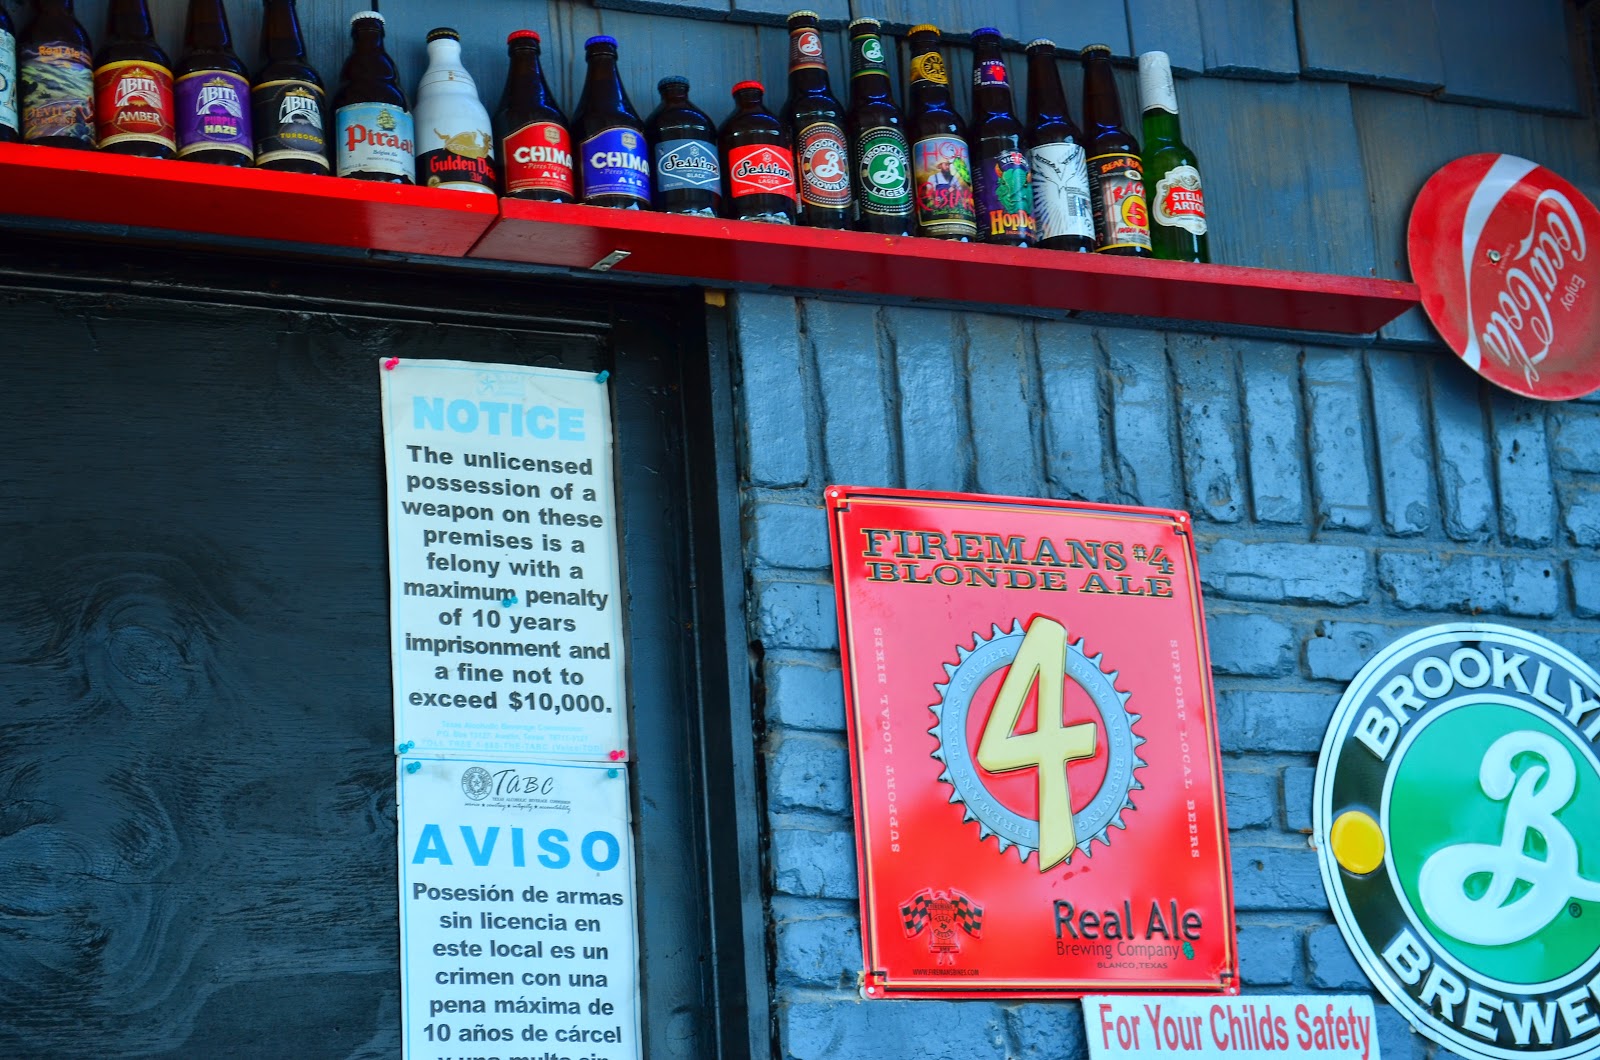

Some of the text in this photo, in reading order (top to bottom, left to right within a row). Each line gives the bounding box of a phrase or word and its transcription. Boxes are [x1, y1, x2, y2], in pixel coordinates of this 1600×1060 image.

[38, 46, 62, 56] Real
[116, 75, 160, 106] ABITA
[196, 85, 239, 114] ABITA
[116, 110, 162, 127] AMBER
[278, 96, 320, 121] ABITA
[204, 116, 236, 127] PURPLE
[204, 124, 237, 136] HAZE
[513, 146, 573, 170] CHIMA
[590, 152, 650, 176] CHIMA
[664, 154, 718, 176] Session
[862, 144, 907, 166] BROOKLYN
[1102, 159, 1124, 174] BEAR
[430, 156, 496, 180] Gulden Dra
[542, 171, 567, 181] ALE
[738, 162, 793, 180] Session
[618, 176, 642, 186] ALE
[806, 172, 840, 190] BROWN
[872, 186, 906, 198] LAGER
[1126, 202, 1147, 226] 5
[1173, 201, 1204, 212] ARTO
[989, 209, 1036, 235] HopDe
[1483, 189, 1586, 391] Coca-Cola
[1563, 274, 1586, 312] Enjoy
[412, 396, 586, 441] NOTICE
[406, 444, 593, 476] The unlicensed
[406, 474, 597, 502] possession of a
[401, 501, 603, 528] weapon on these
[423, 529, 585, 554] premises is a
[860, 528, 1175, 576] FIREMANS #4
[426, 552, 584, 580] felony with a
[866, 561, 1174, 598] BLONDE ALE
[404, 581, 609, 612] maximum penalty
[438, 608, 576, 634] of 10 years
[405, 632, 610, 660] imprisonment and
[434, 662, 584, 686] a fine not to
[408, 691, 612, 715] exceed $10,000.
[874, 627, 900, 853] SUPPORT LOCAL BIKES
[977, 614, 1097, 874] 4
[1071, 661, 1126, 832] REAL ALE BREWING
[1170, 639, 1200, 858] SUPPORT LOCAL BEERS
[412, 824, 620, 872] AVISO
[412, 882, 624, 906] Posesión de armas
[439, 912, 601, 932] sin licencia en
[1053, 898, 1202, 940] Real Ale
[432, 940, 609, 960] este local es un
[1056, 941, 1180, 960] Brewing Company
[434, 967, 608, 988] crimen con una
[430, 996, 614, 1018] pena máxima de
[423, 1023, 622, 1044] 10 años de cárcel
[1099, 1003, 1371, 1060] For Your Childs Safety
